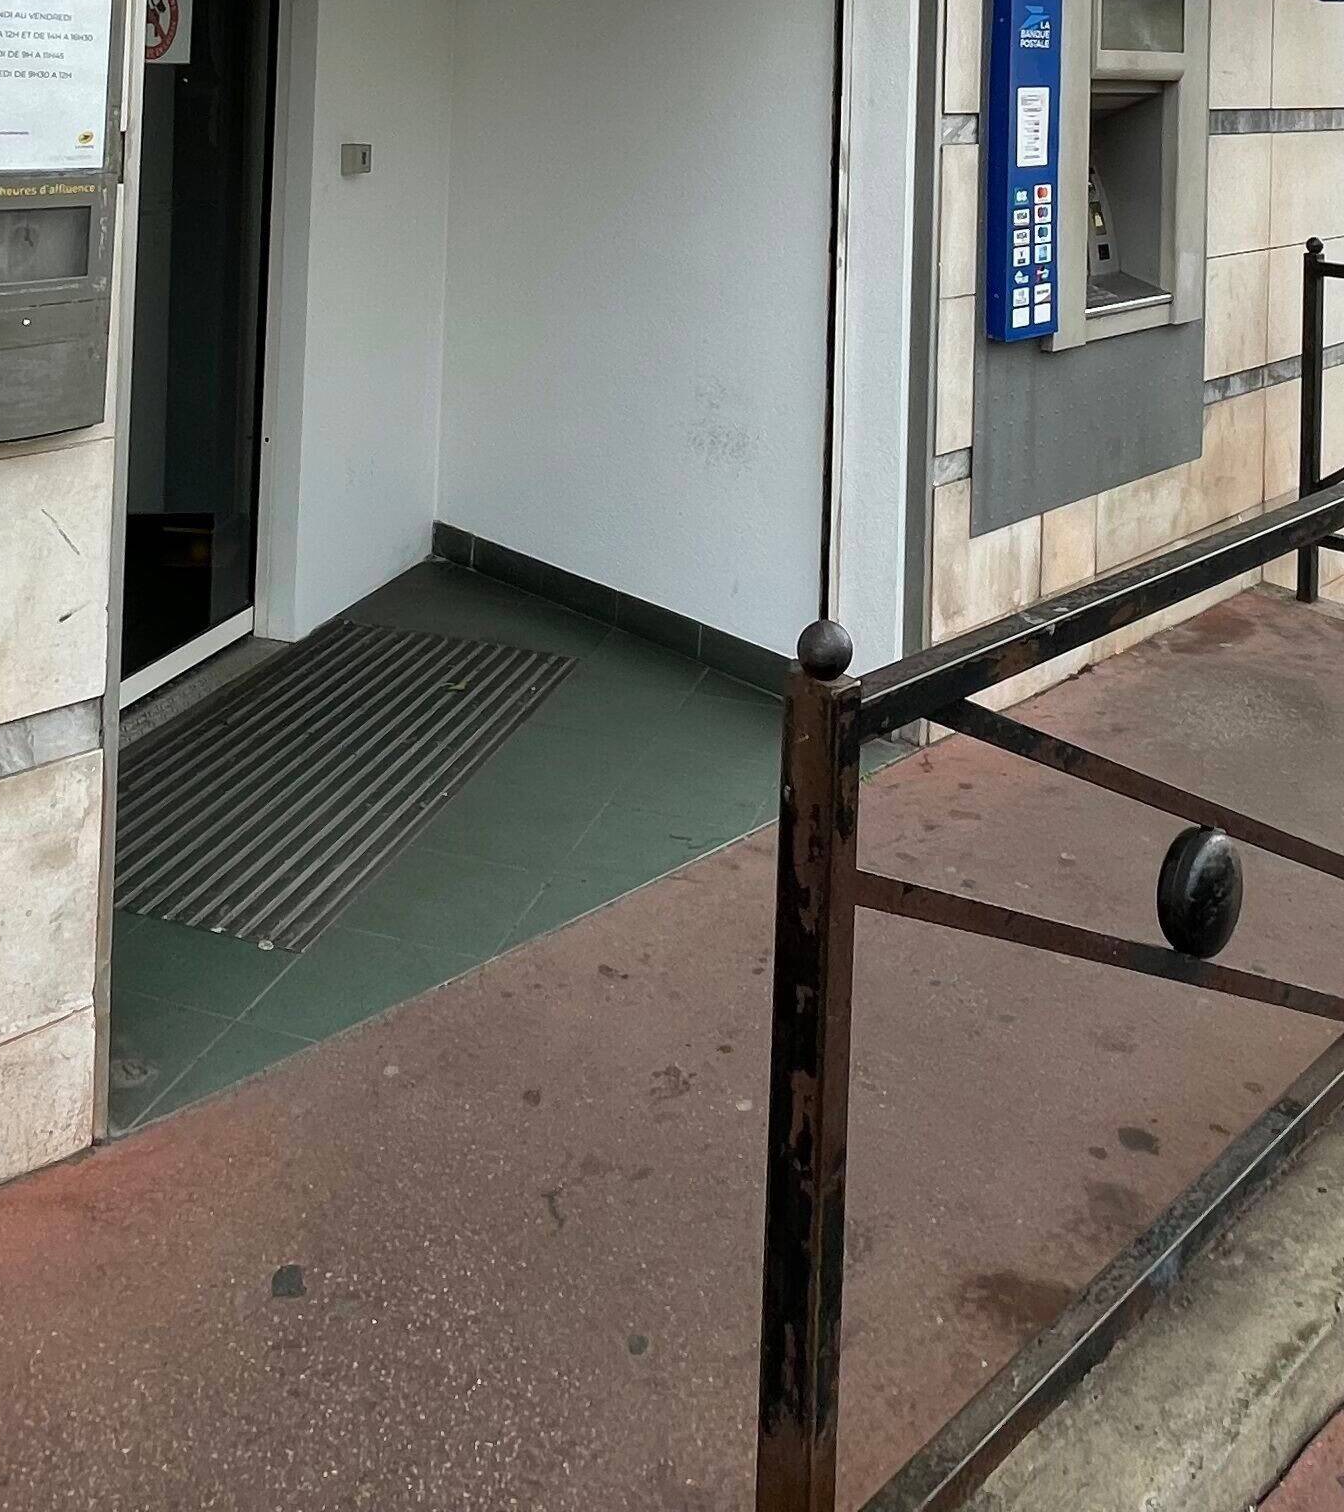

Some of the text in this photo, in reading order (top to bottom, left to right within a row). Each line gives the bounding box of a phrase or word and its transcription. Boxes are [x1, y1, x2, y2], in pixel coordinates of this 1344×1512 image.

[14, 11, 27, 19] AU
[28, 12, 72, 21] VENDREDI
[1040, 21, 1050, 29] LA
[33, 32, 45, 40] DE
[1020, 29, 1050, 39] BANQUE
[1019, 38, 1050, 49] POSTALE
[8, 50, 19, 58] DE
[14, 70, 27, 78] DE
[0, 185, 37, 197] heures
[39, 184, 96, 196] d'affluence
